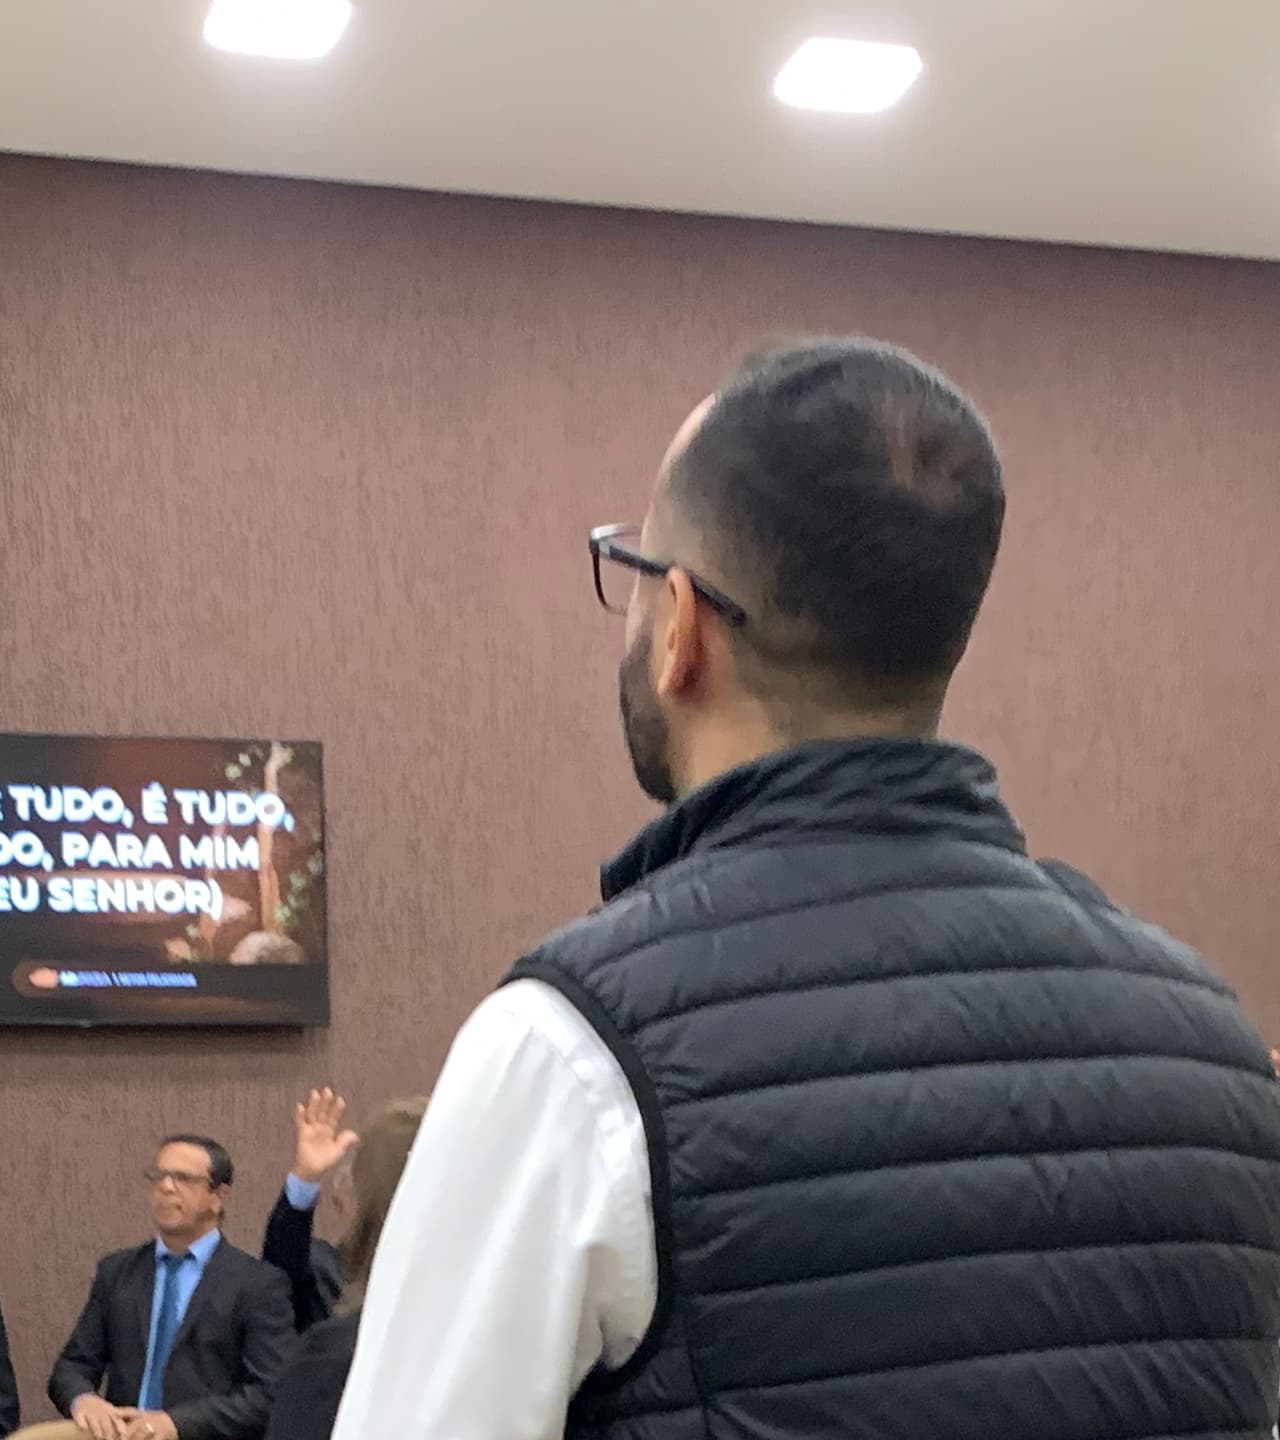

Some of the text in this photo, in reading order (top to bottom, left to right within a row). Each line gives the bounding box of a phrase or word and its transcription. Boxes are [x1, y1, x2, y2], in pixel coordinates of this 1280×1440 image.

[7, 784, 134, 829] TUDO,
[141, 781, 169, 824] É
[173, 788, 295, 832] TUDO,
[61, 832, 173, 869] PARA
[179, 834, 260, 870] MIM
[47, 877, 223, 921] SENHOR)
